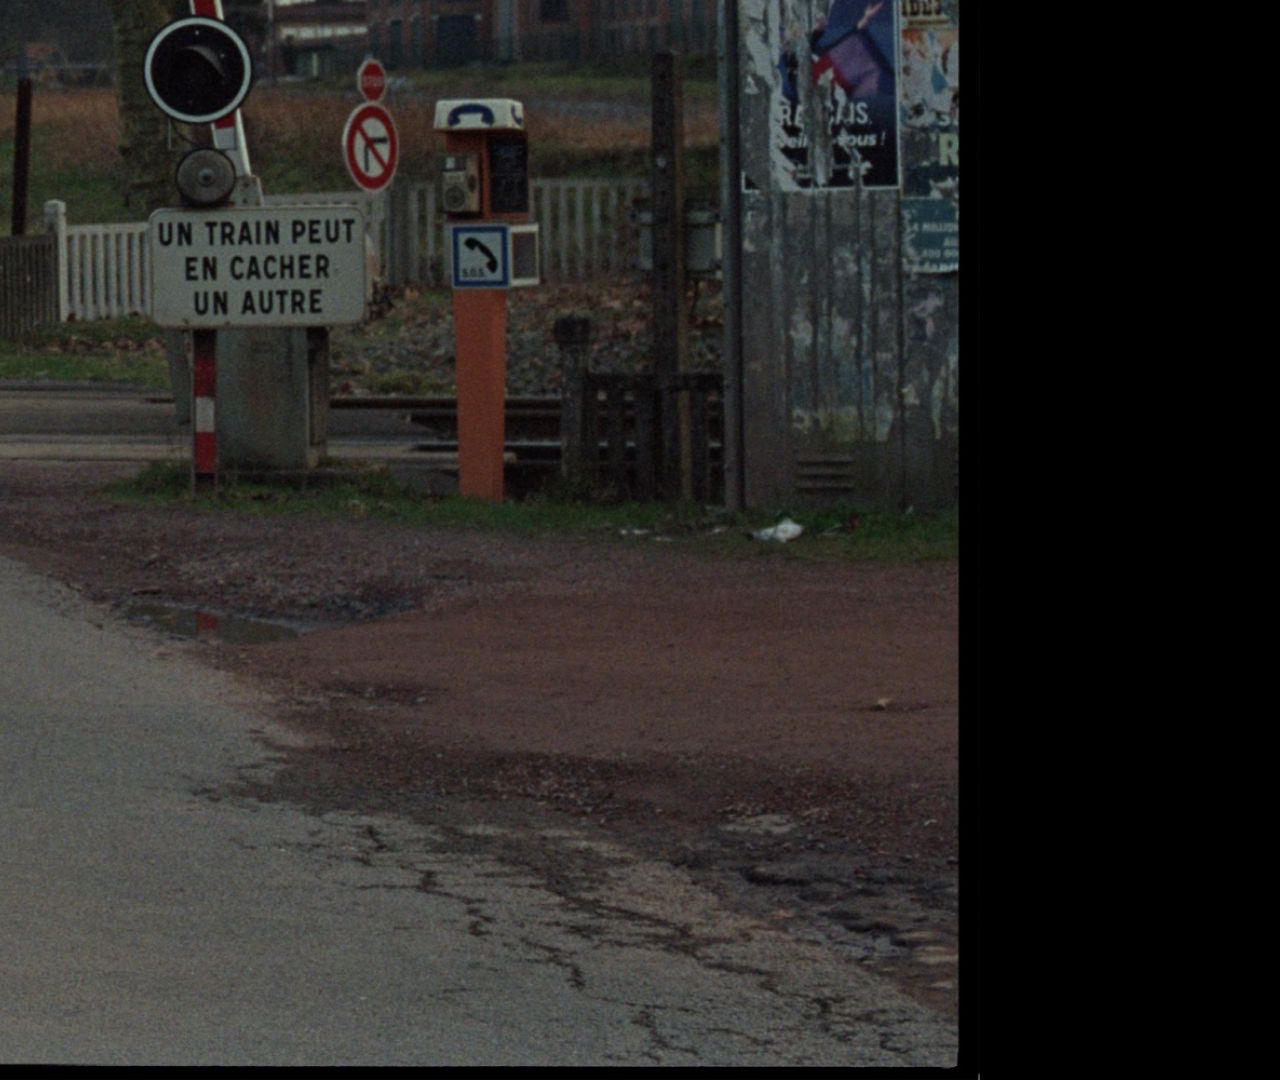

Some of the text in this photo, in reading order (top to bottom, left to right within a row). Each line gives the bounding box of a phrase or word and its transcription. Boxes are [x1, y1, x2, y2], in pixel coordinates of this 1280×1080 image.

[158, 219, 356, 246] UN TRAIN PEUT
[185, 255, 330, 281] EN CACHER
[194, 290, 322, 315] UN AUTRE
